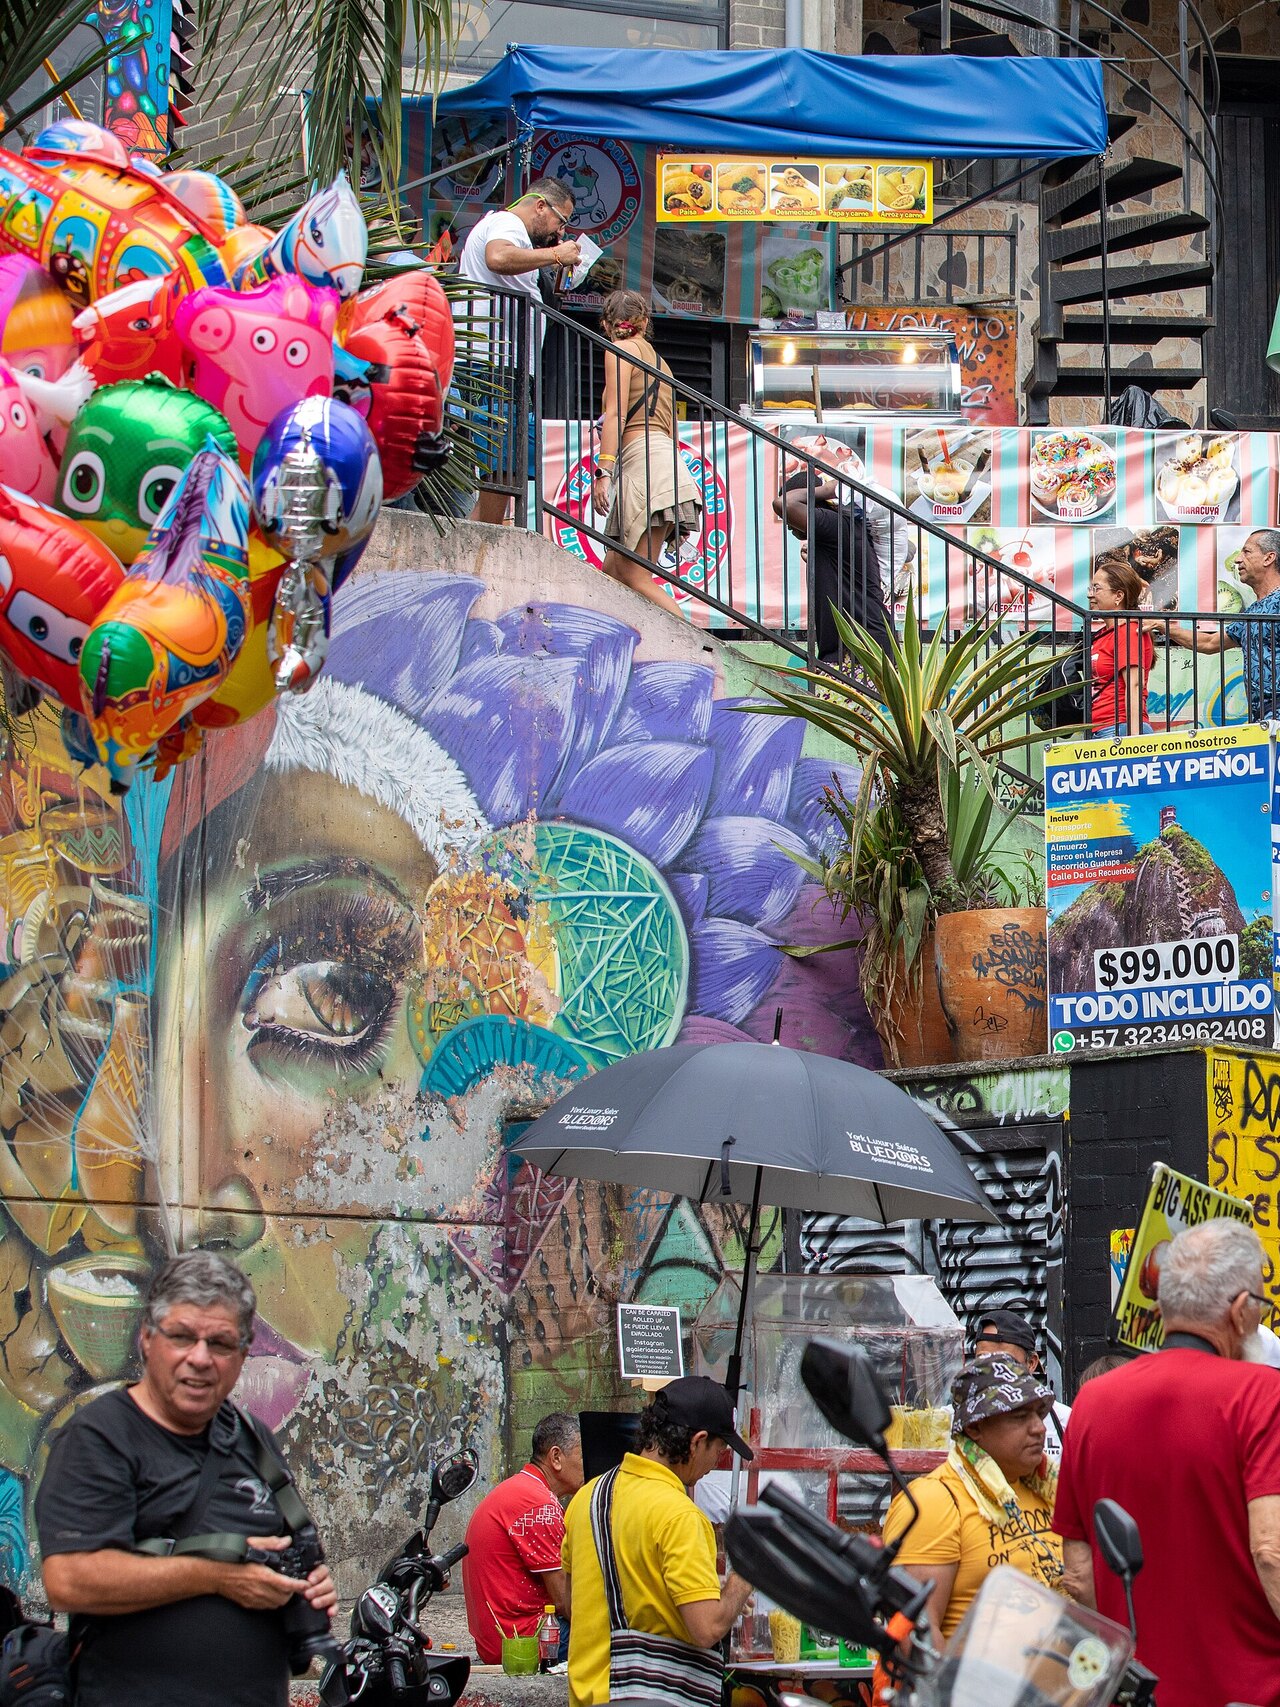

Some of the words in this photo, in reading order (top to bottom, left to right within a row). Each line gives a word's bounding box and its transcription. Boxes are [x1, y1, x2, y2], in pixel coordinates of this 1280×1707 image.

[602, 138, 638, 188] POLAR
[453, 184, 481, 196] MANGO
[678, 207, 698, 217] Paisa
[727, 206, 757, 217] Maicitos
[775, 207, 818, 218] Desmechada
[828, 208, 844, 219] Papa
[850, 209, 870, 219] carne
[671, 300, 703, 312] BROWNIE
[932, 504, 963, 516] MANGO
[1177, 504, 1221, 517] MARACUYÁ
[1074, 748, 1097, 761] Ven
[1099, 749, 1107, 758] a
[1109, 742, 1160, 757] Conocer
[1161, 738, 1183, 752] con
[1185, 734, 1238, 750] nosotros
[1051, 755, 1162, 795] GUATAPÉ
[1164, 759, 1182, 783] Y
[1185, 748, 1265, 782] PEÑOL
[1049, 813, 1079, 824] Incluye
[1050, 821, 1092, 832] Transporte
[1050, 841, 1088, 852] Almuerzo
[1050, 852, 1074, 862] Barco
[1086, 850, 1093, 859] la
[1094, 847, 1124, 859] Represa
[1050, 861, 1089, 871] Recorrido
[1050, 871, 1073, 881] Calle
[1073, 870, 1084, 879] De
[1085, 869, 1097, 878] los
[1098, 866, 1135, 878] Recuerdos
[1098, 938, 1235, 991] $99.000
[1055, 993, 1139, 1024] TODO
[1141, 977, 1273, 1021] INCLUÍDO
[1076, 1028, 1120, 1049] +57
[1124, 1018, 1267, 1048] 3234962408
[845, 1131, 866, 1143] York
[866, 1135, 895, 1150] Luxury
[895, 1142, 919, 1154] Suites
[1210, 1129, 1238, 1187] SI
[1152, 1173, 1182, 1218] BIG
[1179, 1186, 1212, 1226] ASS
[633, 1339, 665, 1347] Instagram
[987, 1548, 1010, 1568] ON
